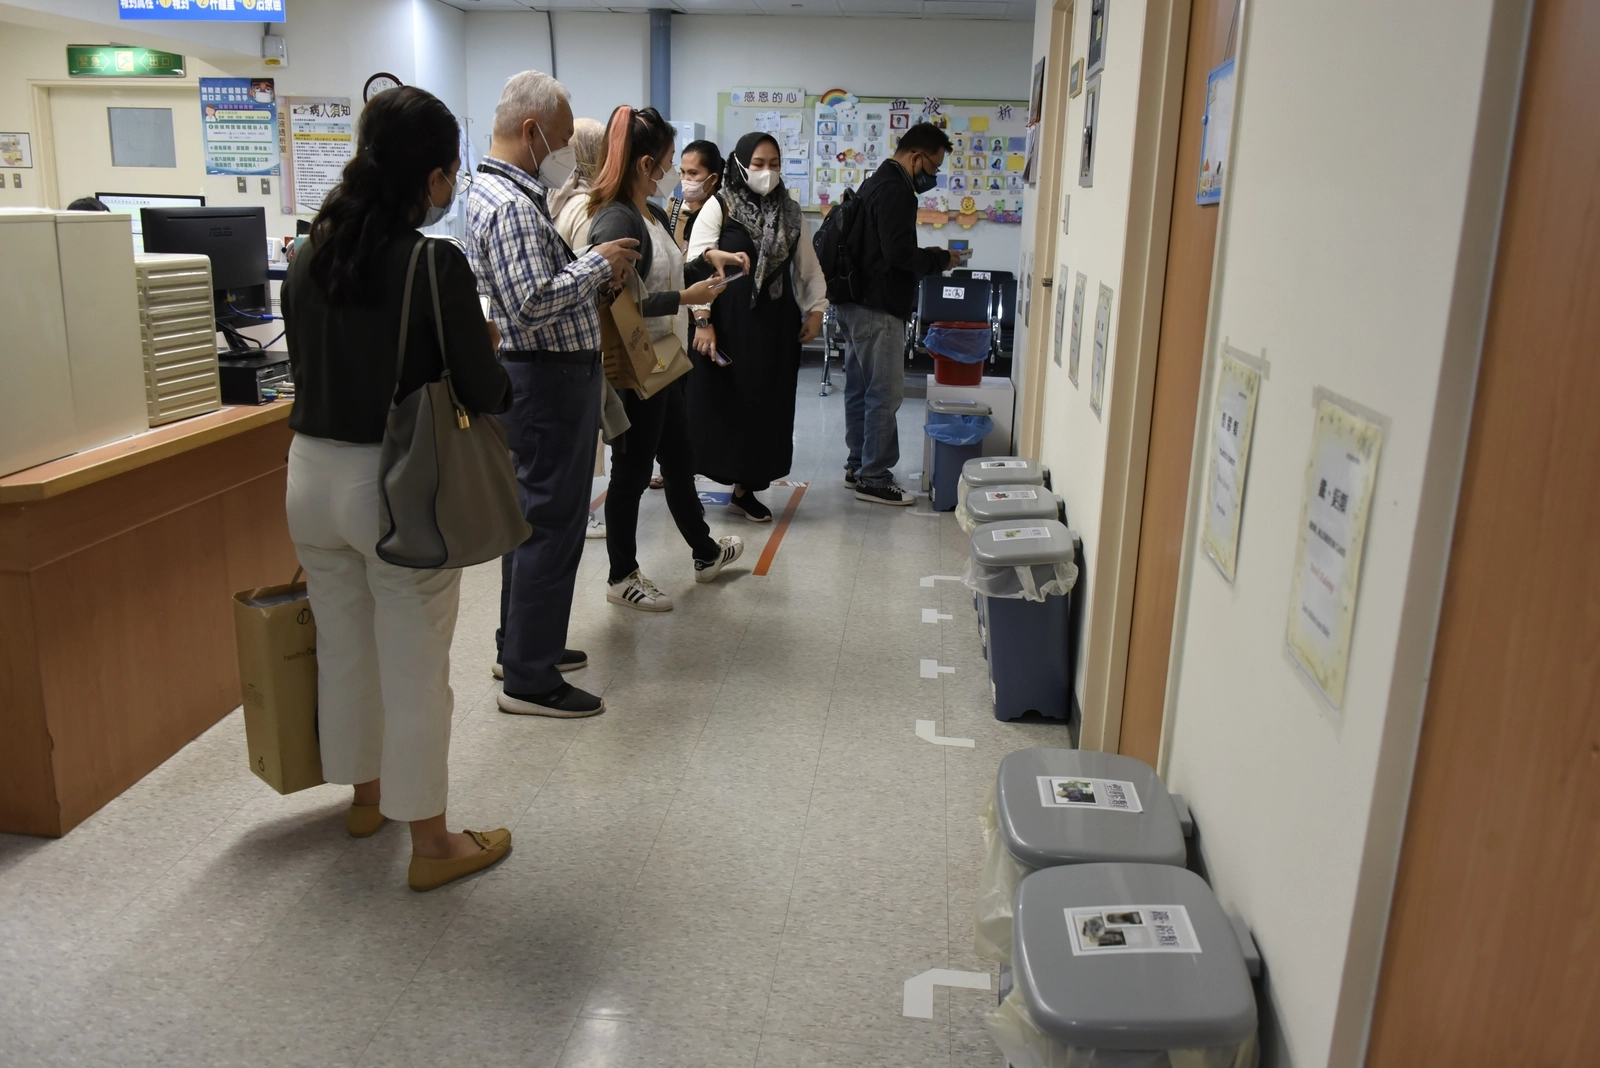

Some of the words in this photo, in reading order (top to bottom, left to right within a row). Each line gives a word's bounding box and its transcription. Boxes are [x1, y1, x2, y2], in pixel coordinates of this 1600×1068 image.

[150, 56, 170, 66] 出口
[744, 91, 797, 103] 感恩的心
[310, 103, 351, 118] 病人須知
[278, 112, 287, 153] 血液透析室
